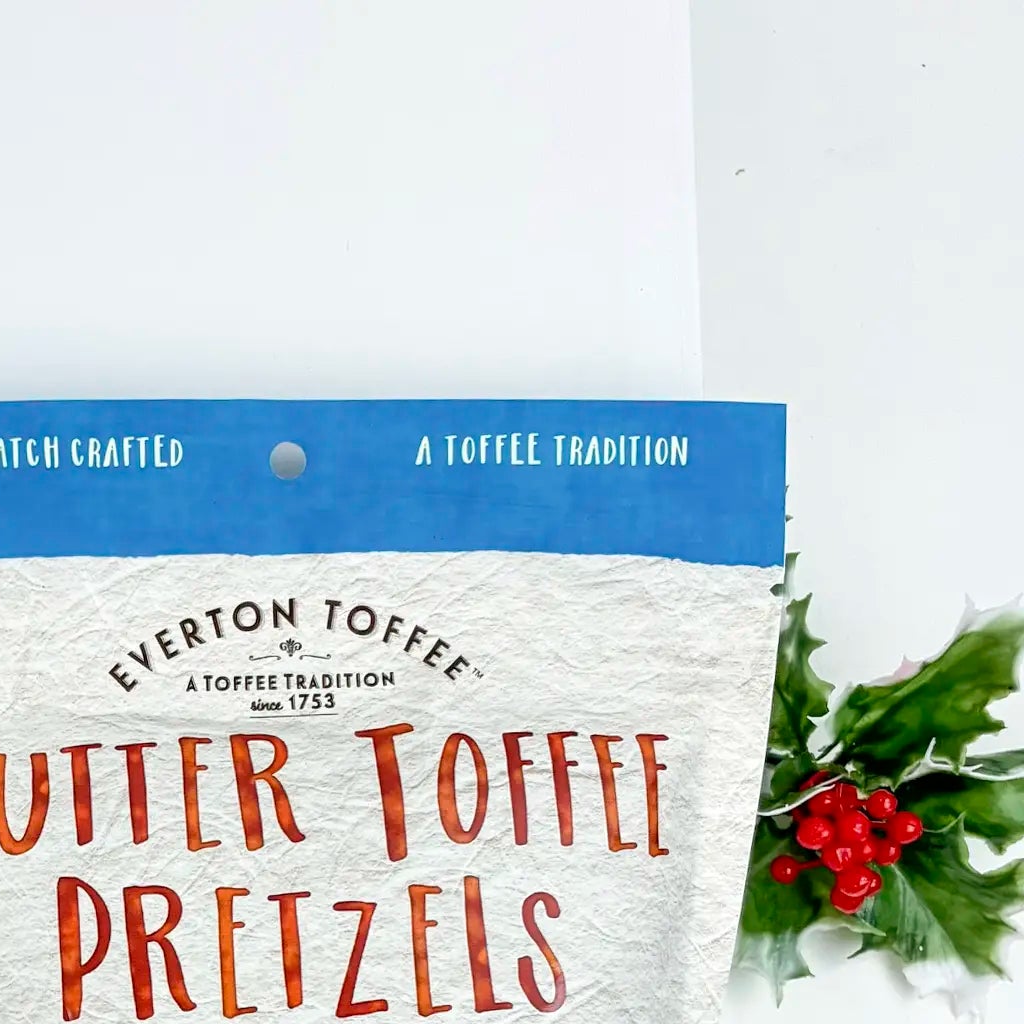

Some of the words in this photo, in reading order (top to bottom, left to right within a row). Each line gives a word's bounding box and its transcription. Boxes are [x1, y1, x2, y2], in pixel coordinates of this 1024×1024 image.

[71, 434, 183, 468] CRAFTED
[415, 436, 431, 466] A
[445, 432, 541, 466] TOFFEE
[553, 434, 688, 467] TRADITION
[108, 598, 296, 692] EVERTON
[324, 599, 470, 681] TOFFEE
[185, 675, 198, 692] A
[203, 674, 277, 691] TOFFEE
[284, 671, 396, 690] TRADITION
[250, 698, 283, 712] since
[288, 693, 335, 710] 1753
[355, 723, 670, 861] TOFFEE
[56, 876, 568, 1022] PRETZELS
